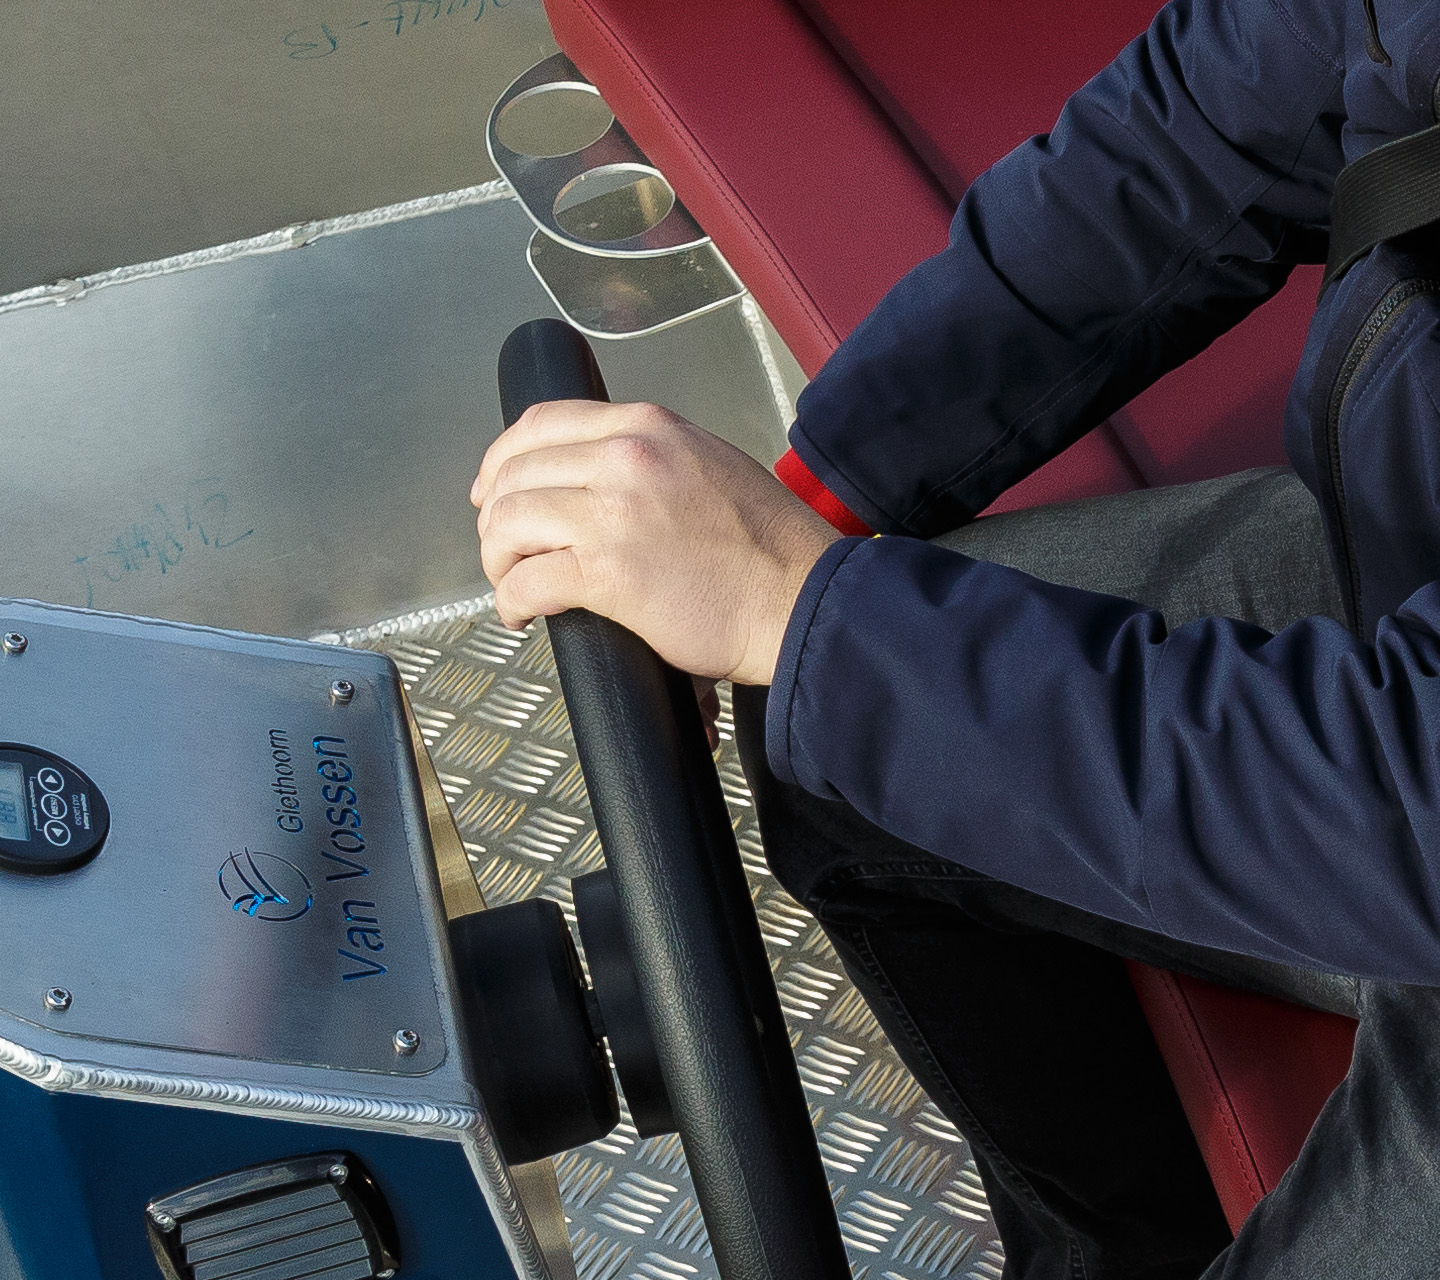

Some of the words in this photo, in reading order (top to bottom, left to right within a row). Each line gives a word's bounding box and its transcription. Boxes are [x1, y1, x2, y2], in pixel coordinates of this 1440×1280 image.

[268, 728, 304, 833] Giethoorn
[312, 734, 370, 883] Vossen
[337, 899, 388, 982] Van
